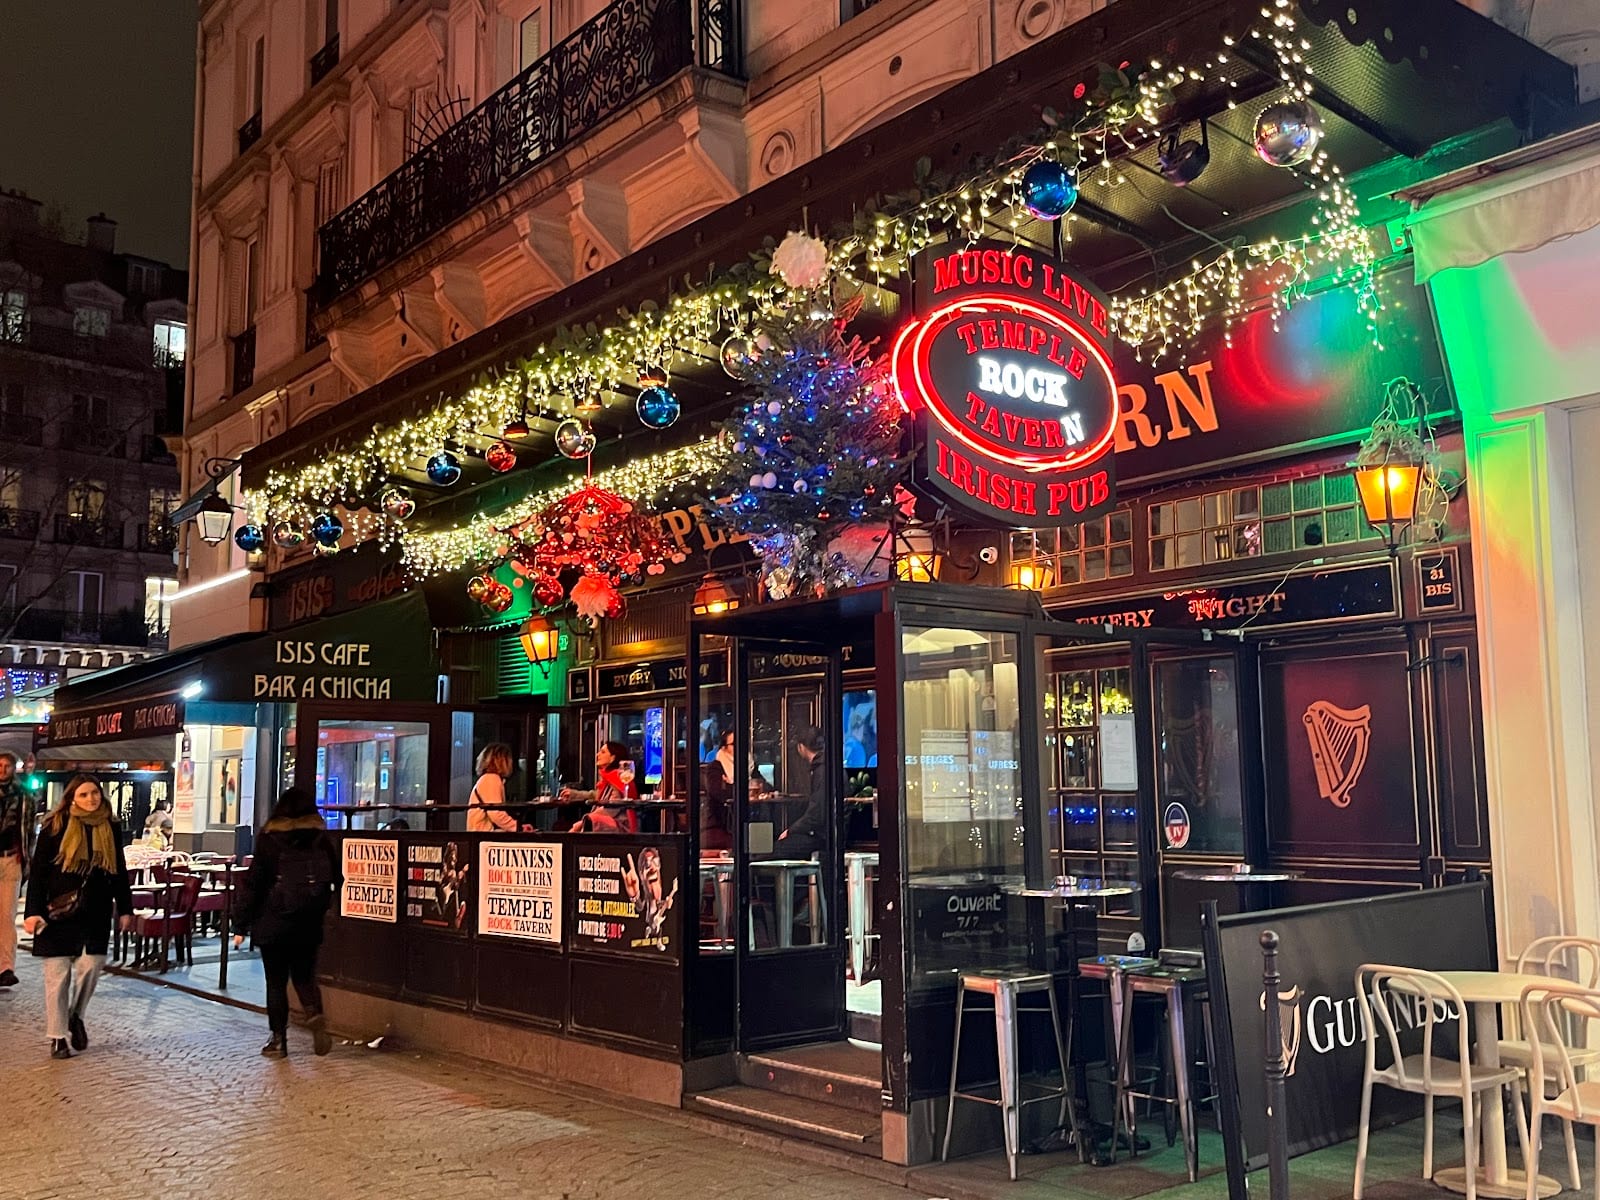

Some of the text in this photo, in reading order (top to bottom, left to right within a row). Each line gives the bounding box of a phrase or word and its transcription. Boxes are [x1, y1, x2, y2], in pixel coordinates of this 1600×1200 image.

[934, 249, 1108, 338] MUSIC LIVE
[957, 320, 1088, 380] TEMPLE
[978, 356, 1068, 407] ROCK
[965, 391, 1085, 447] TAVERN
[935, 438, 1110, 516] IRISH PUB
[1425, 582, 1452, 598] BIS
[276, 640, 371, 666] ISIS CAFE
[254, 674, 391, 700] BAR A CHICHA
[613, 670, 651, 687] EVERY
[347, 844, 395, 862] GUINNESS
[488, 848, 553, 869] GUINNESS
[367, 863, 394, 876] TAVERN
[488, 869, 553, 887] ROCK TAVERN
[346, 885, 394, 904] TEMPLE
[366, 903, 393, 916] TAVERN
[488, 897, 553, 920] TEMPLE
[488, 917, 552, 934] ROCK TAVERN
